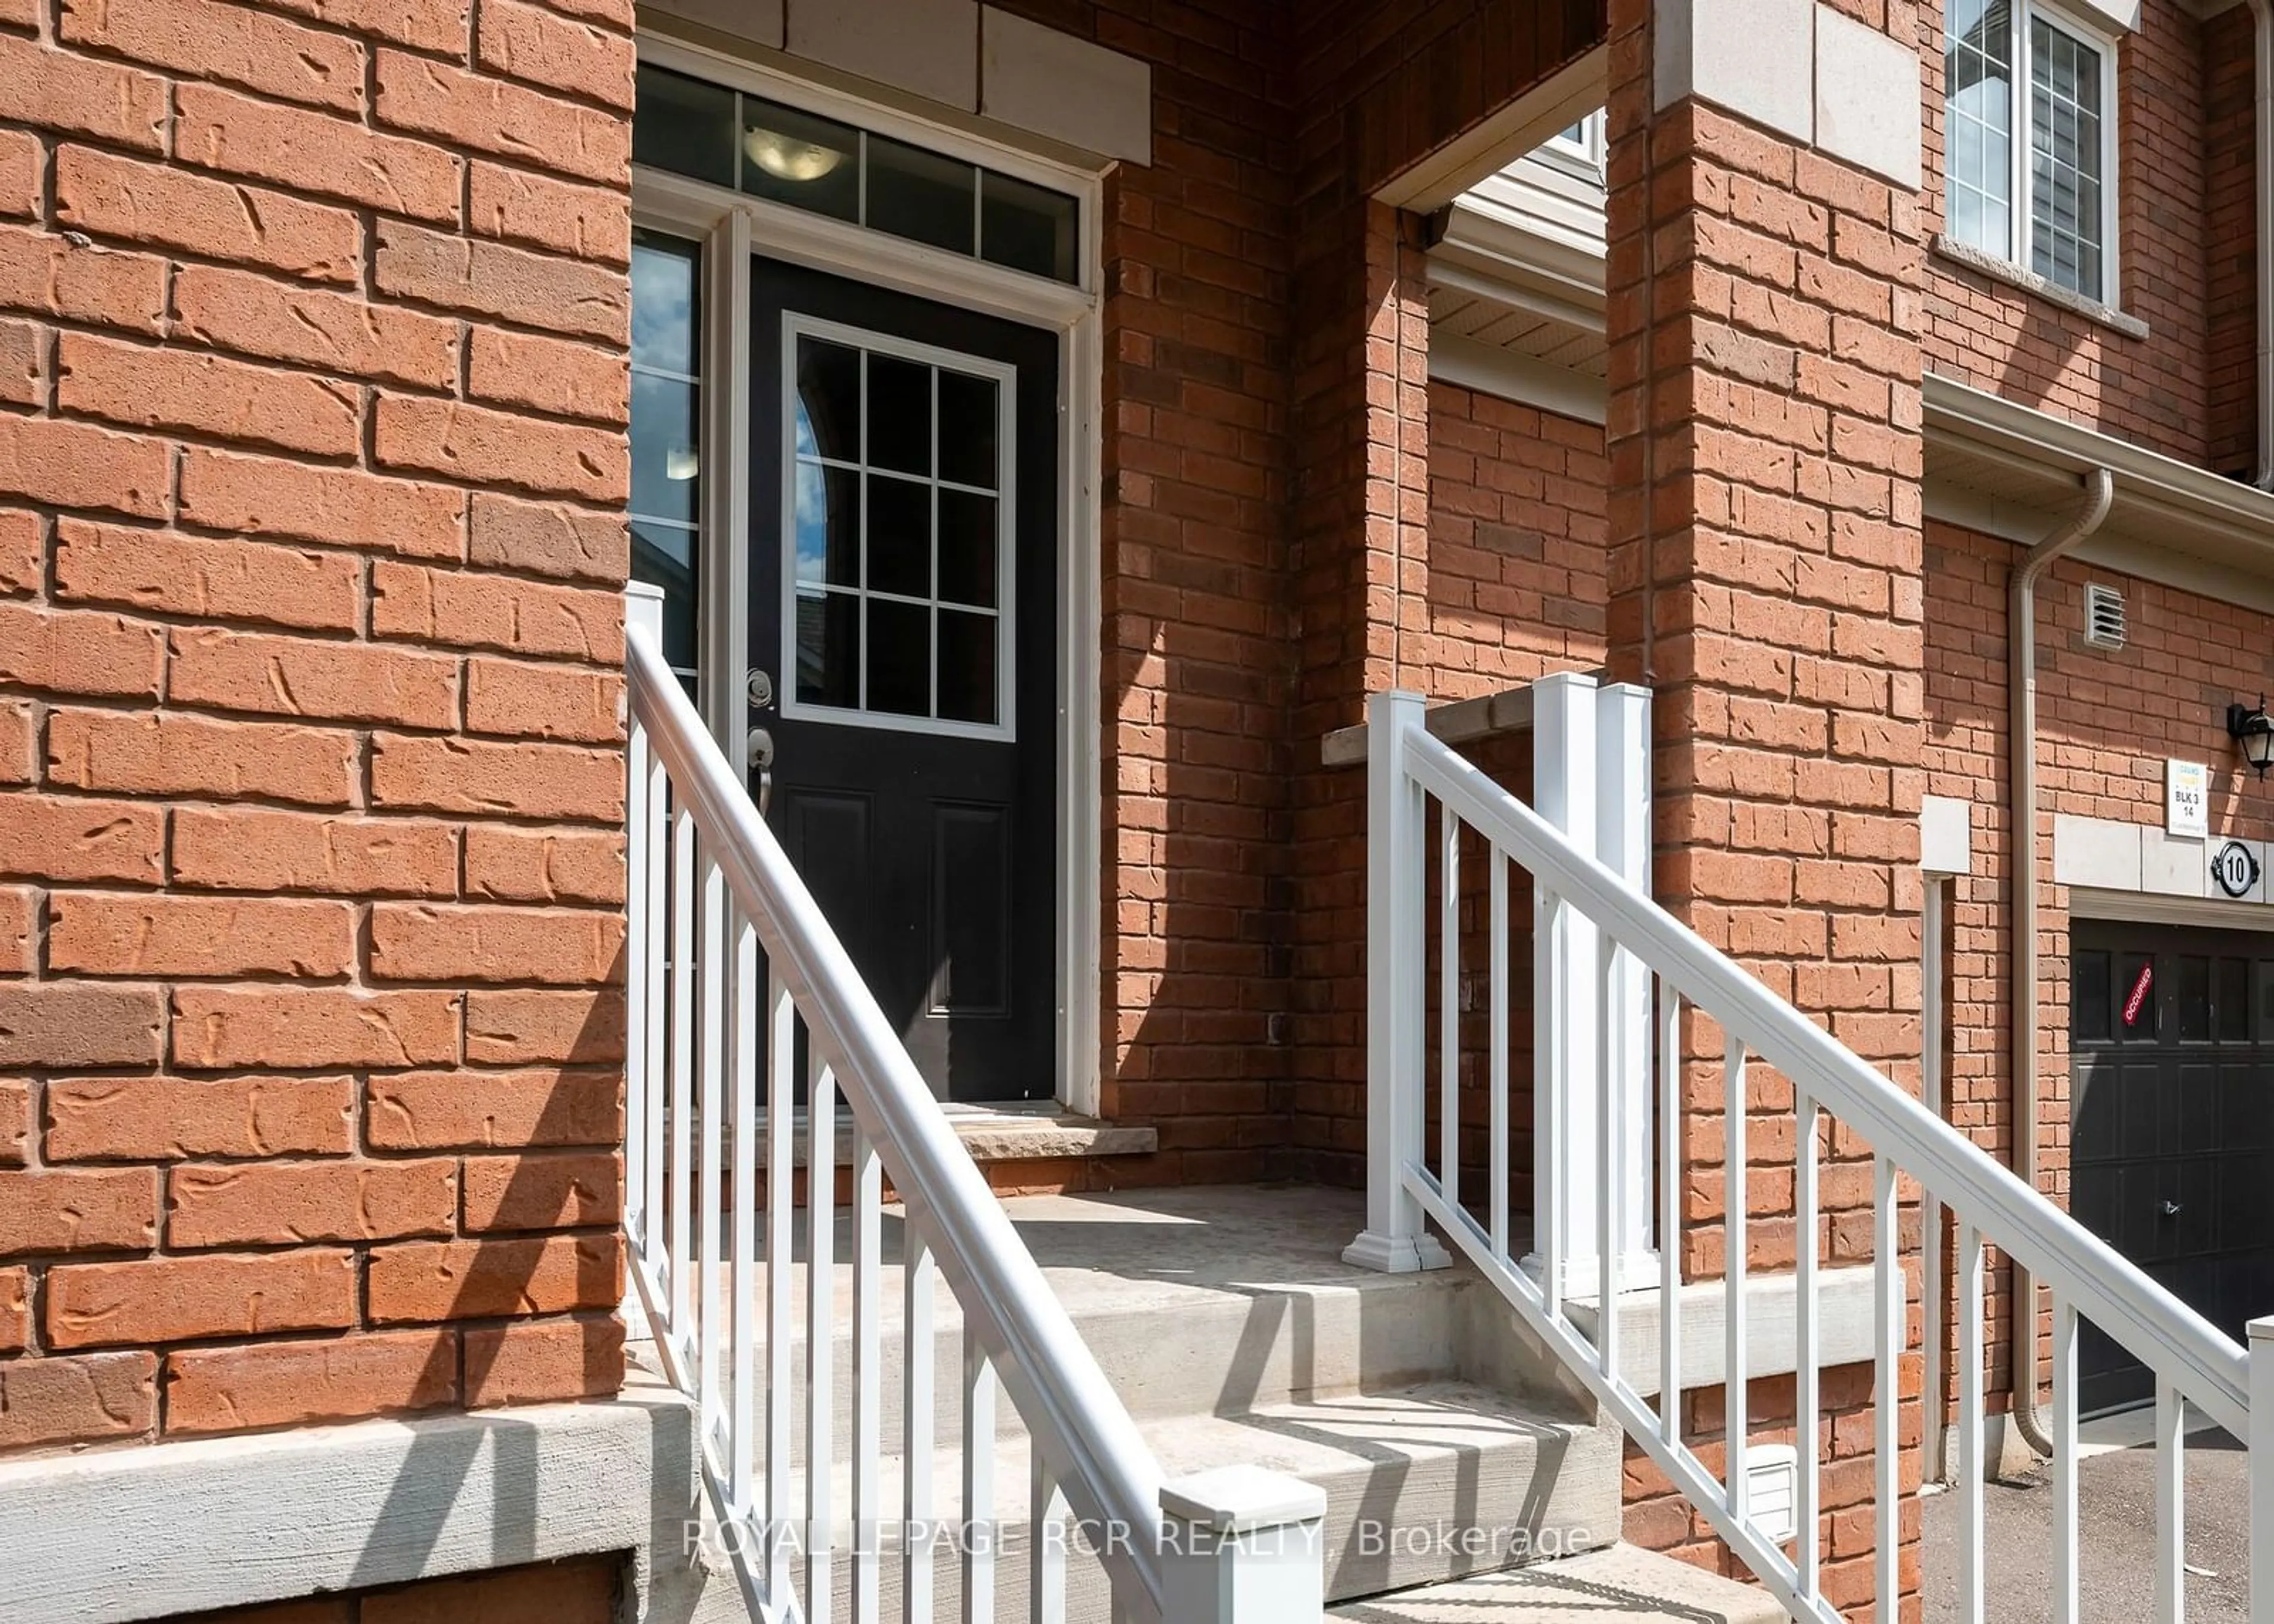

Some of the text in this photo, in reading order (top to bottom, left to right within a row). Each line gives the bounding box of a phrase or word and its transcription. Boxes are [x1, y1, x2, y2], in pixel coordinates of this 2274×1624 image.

[2176, 791, 2199, 805] BLK 3
[2227, 856, 2244, 883] 10
[2126, 967, 2151, 1021] OCCUPIED
